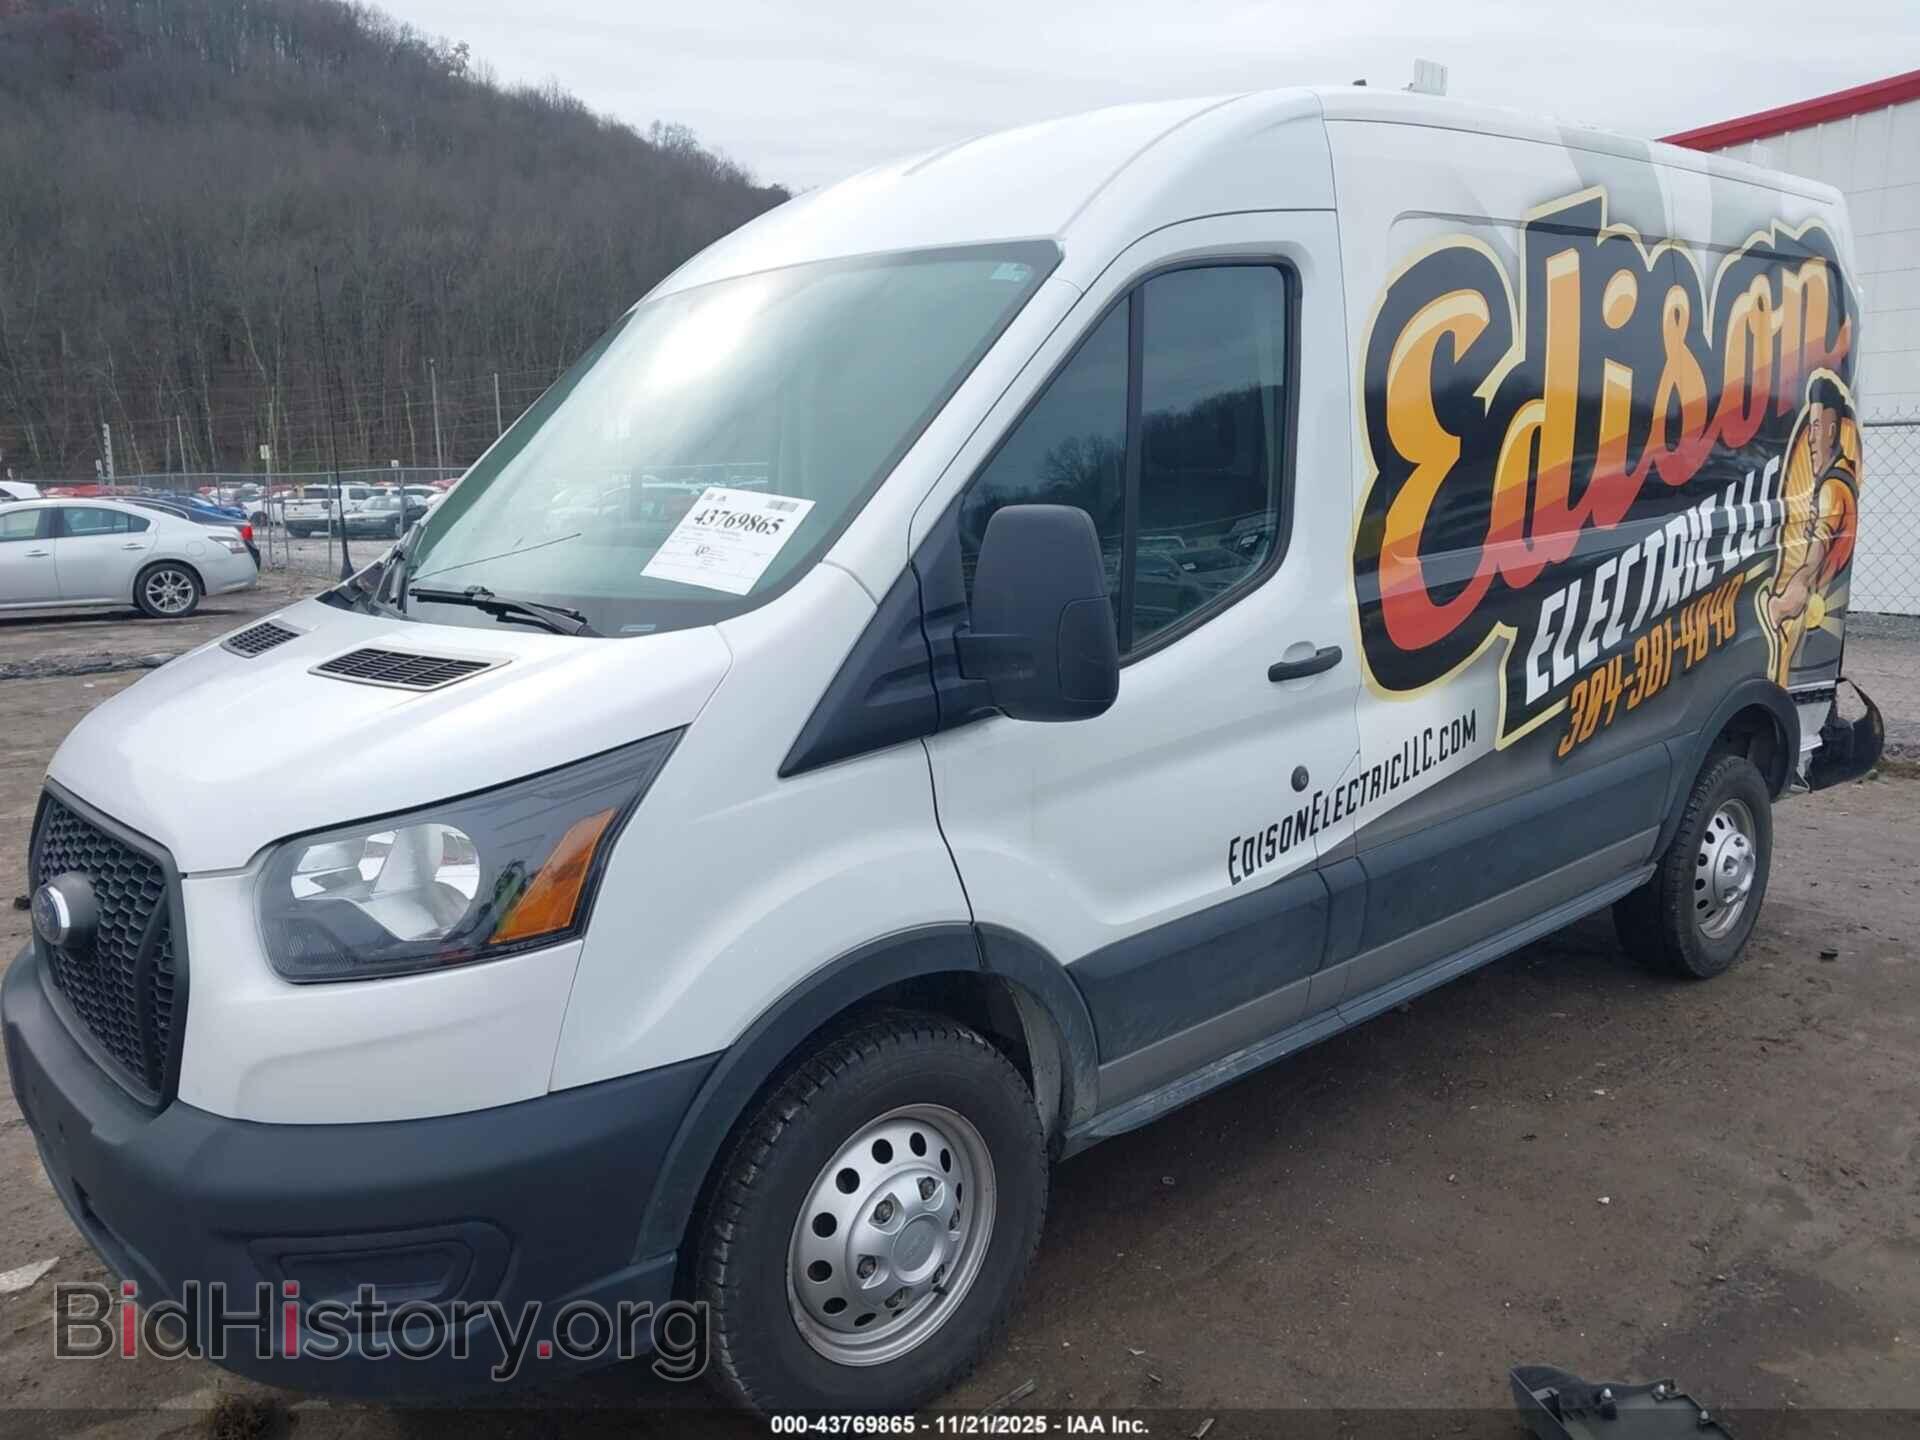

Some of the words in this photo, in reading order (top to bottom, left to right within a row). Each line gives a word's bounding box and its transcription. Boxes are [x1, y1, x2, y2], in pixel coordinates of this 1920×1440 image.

[694, 508, 785, 535] 43769865
[1379, 247, 1852, 650] Edison
[1525, 494, 1718, 705] ELECTRIC
[1722, 455, 1780, 574] LLC
[1557, 572, 1745, 757] 304-381-4040
